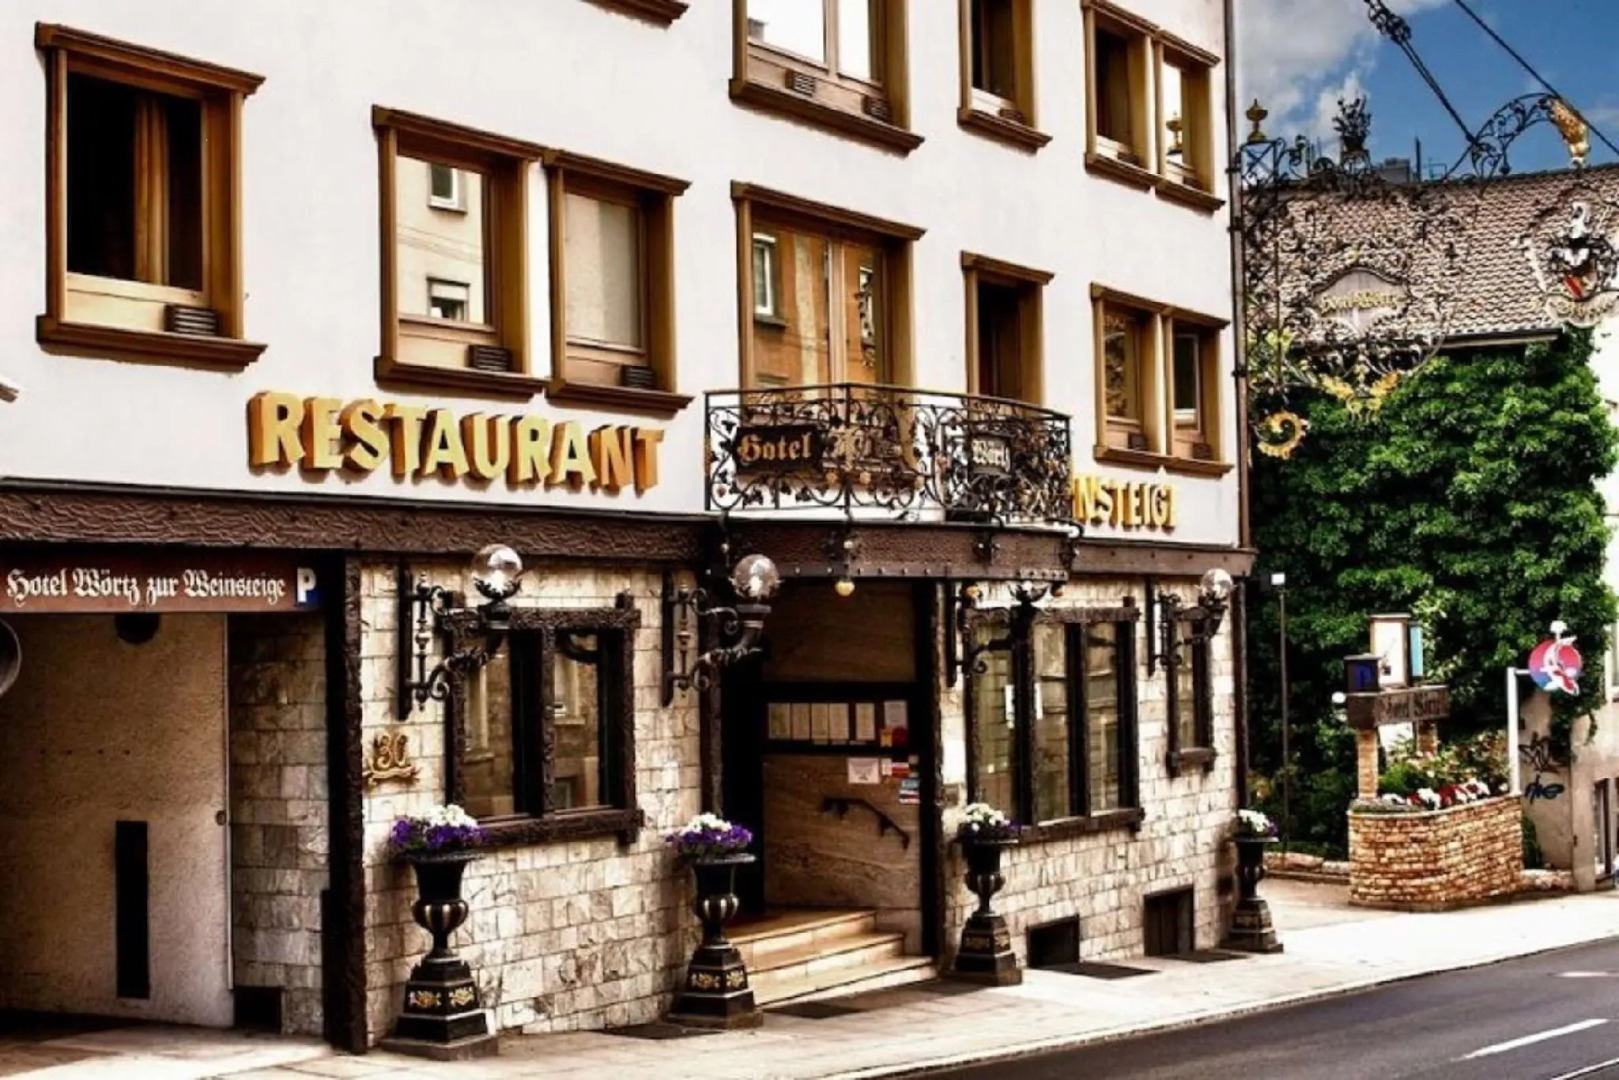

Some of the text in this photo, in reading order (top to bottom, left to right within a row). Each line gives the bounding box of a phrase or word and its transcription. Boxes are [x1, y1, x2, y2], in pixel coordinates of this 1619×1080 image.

[247, 391, 665, 496] RESTAURANT
[7, 568, 286, 607] Hotel Wörtz zur Weinsteige
[297, 566, 317, 603] P
